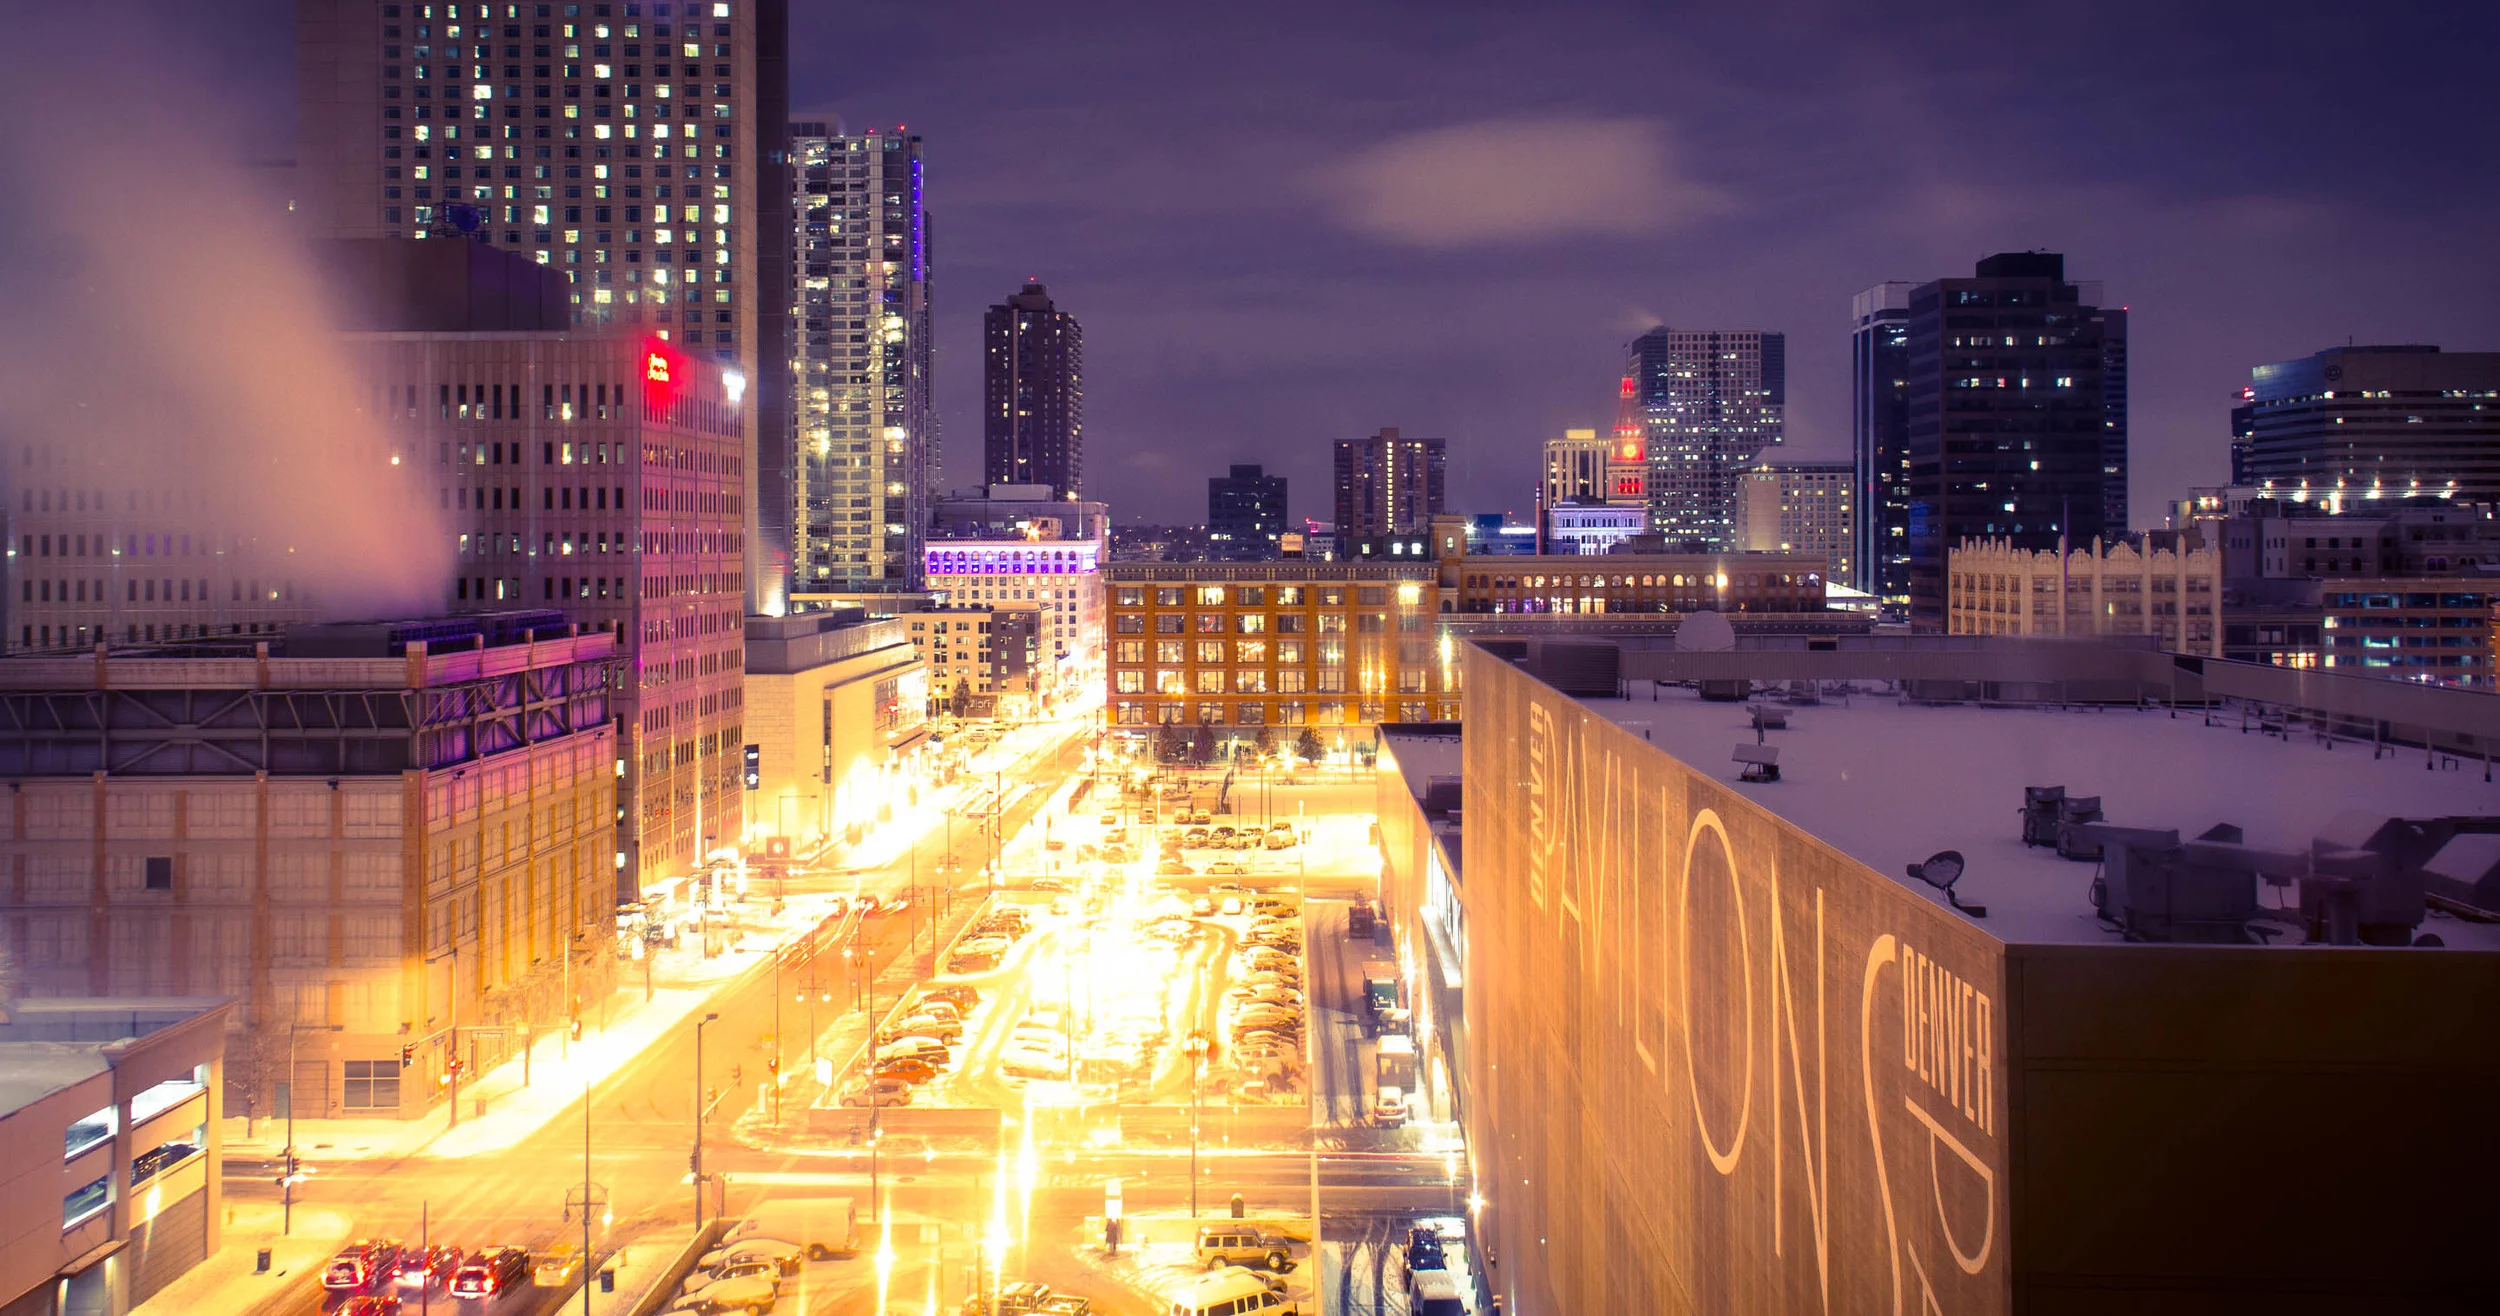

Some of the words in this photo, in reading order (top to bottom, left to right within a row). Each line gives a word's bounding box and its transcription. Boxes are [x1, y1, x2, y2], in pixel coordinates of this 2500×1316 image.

[1530, 700, 1544, 912] DENVER
[1543, 708, 1902, 1316] PAVILIONS
[1902, 942, 1993, 1137] DENVER
